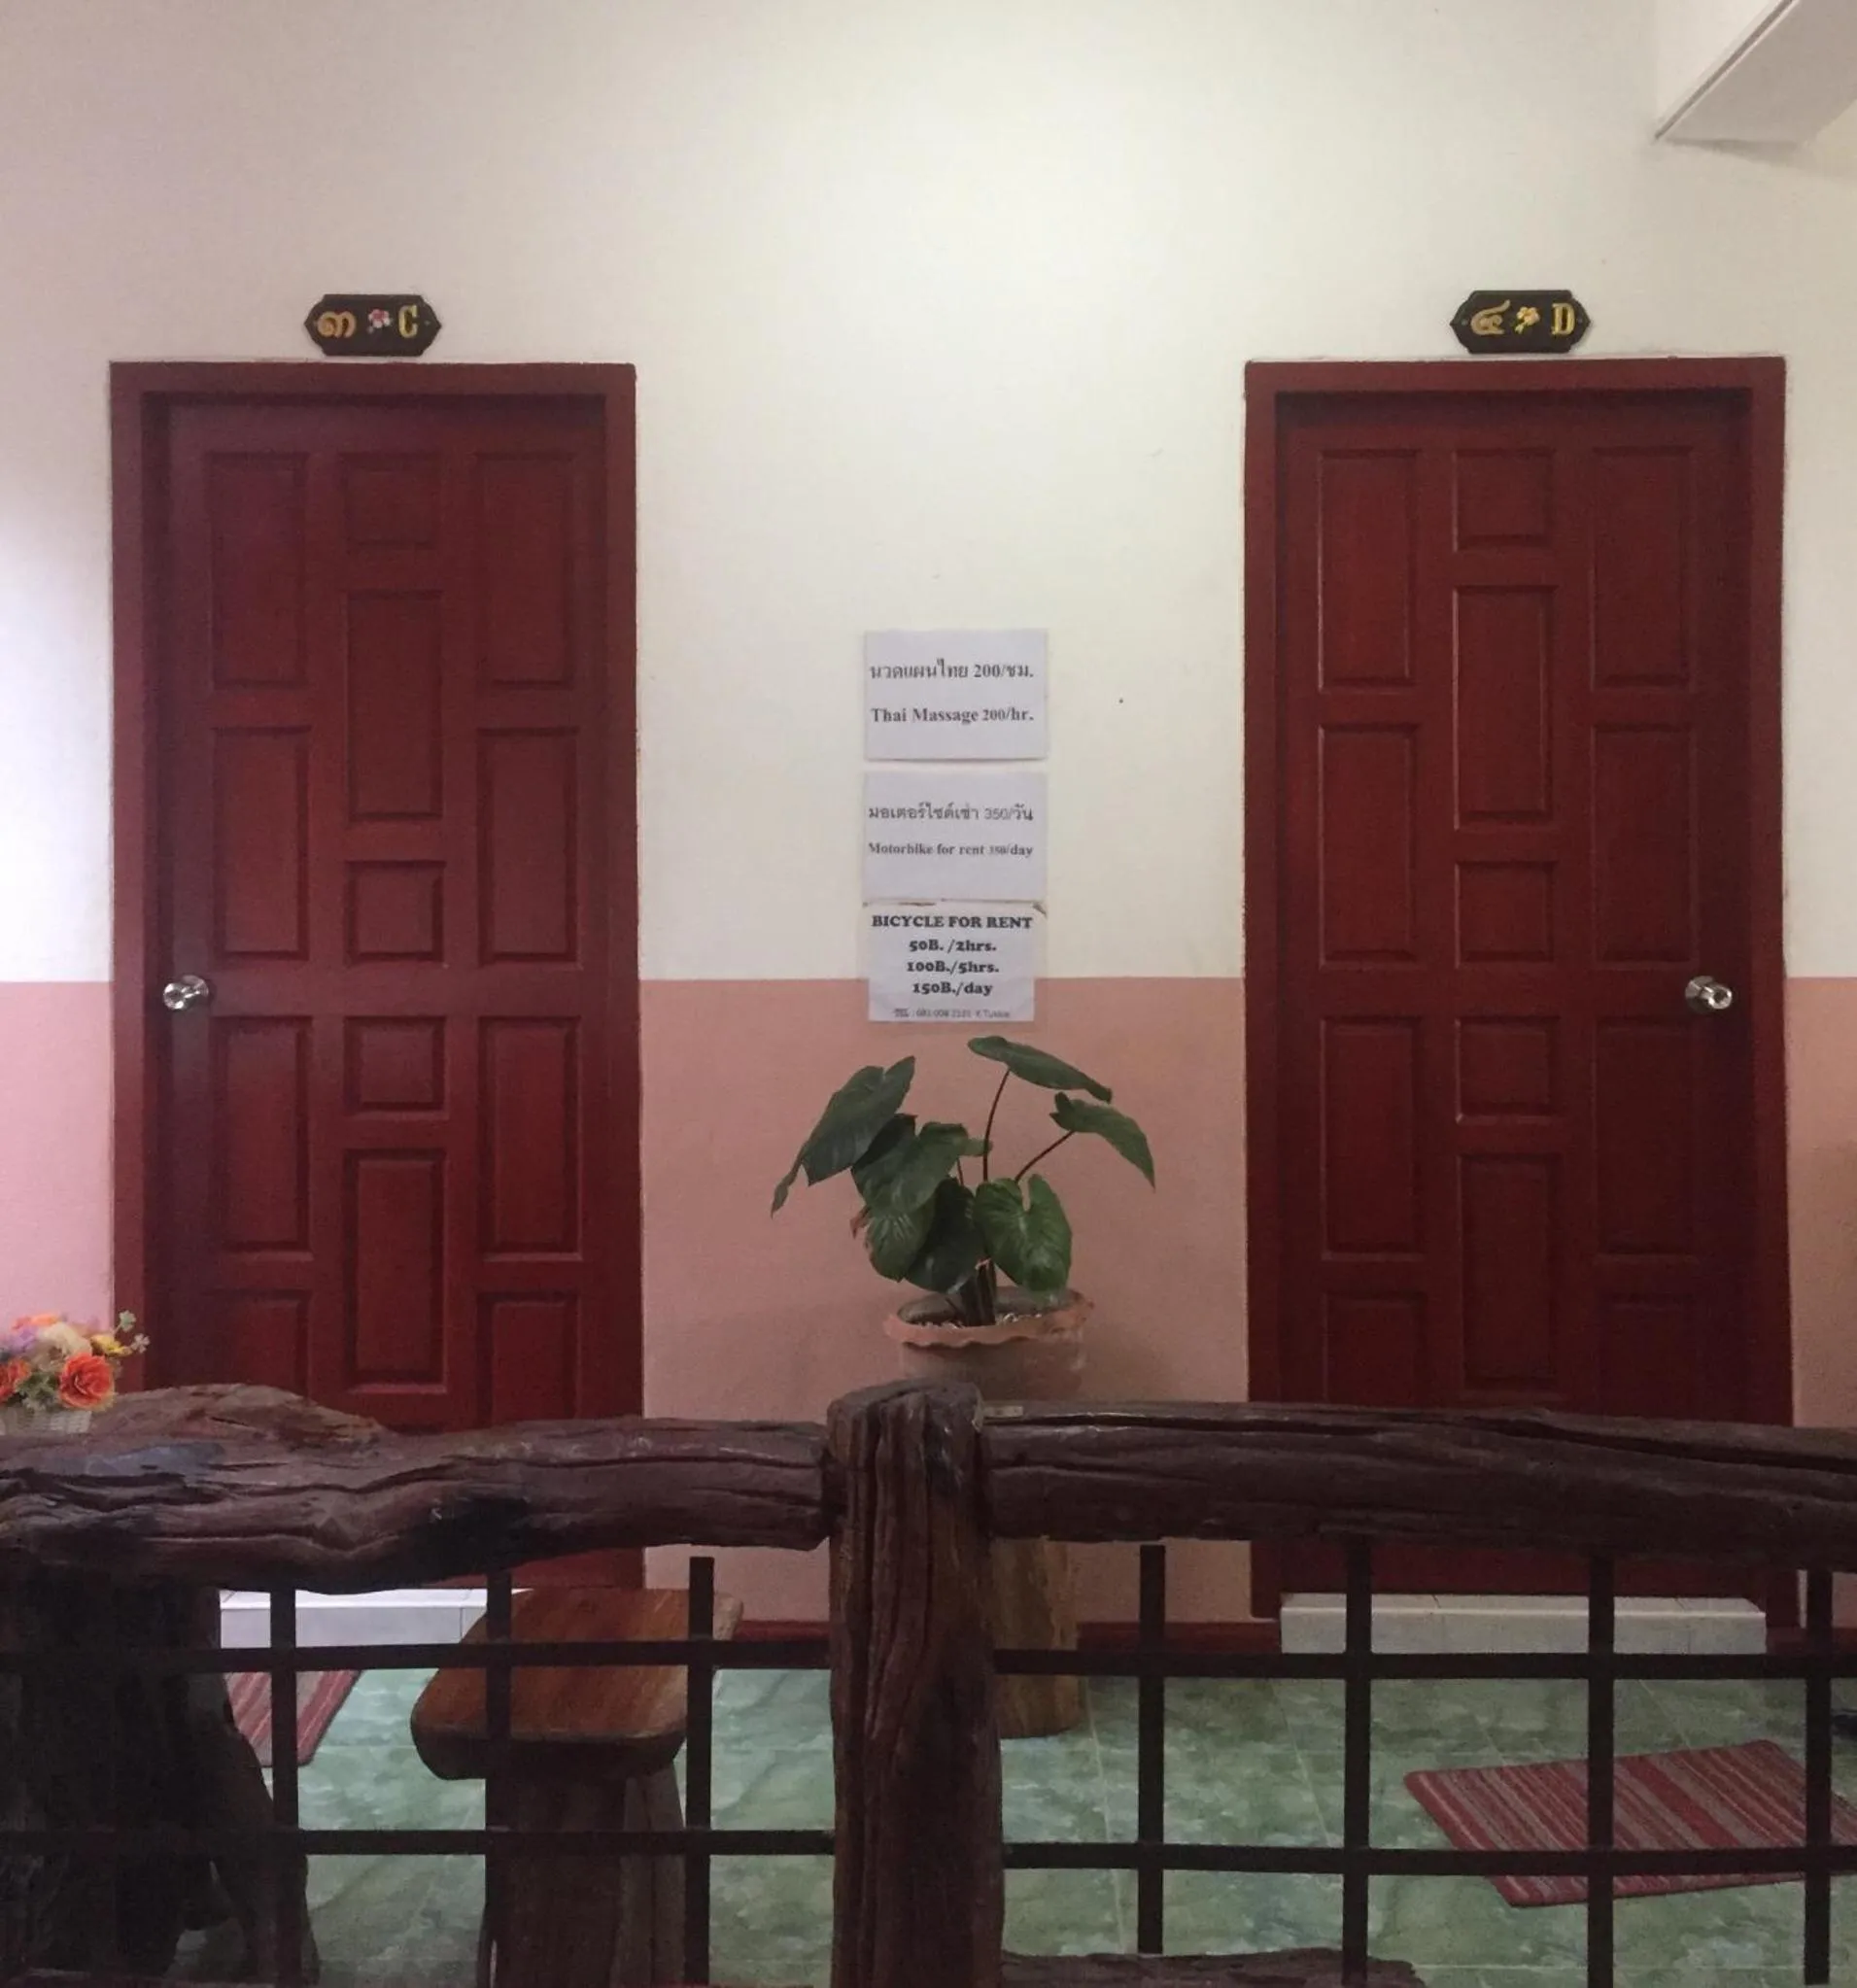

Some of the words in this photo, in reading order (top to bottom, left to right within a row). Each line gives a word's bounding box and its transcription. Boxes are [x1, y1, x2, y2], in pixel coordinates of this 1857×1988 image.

[398, 304, 419, 339] C
[1551, 302, 1576, 335] D
[871, 707, 908, 723] Thai
[911, 707, 980, 725] Massage
[981, 706, 1035, 722] 200/hr.
[868, 841, 934, 856] Motorbike
[936, 842, 955, 856] for
[958, 843, 984, 856] rent
[872, 915, 945, 928] BICYCLE
[948, 915, 982, 929] FOR
[985, 916, 1033, 930] RENT
[907, 959, 1000, 976] 100B./5hrs.
[911, 981, 994, 997] 150B./day
